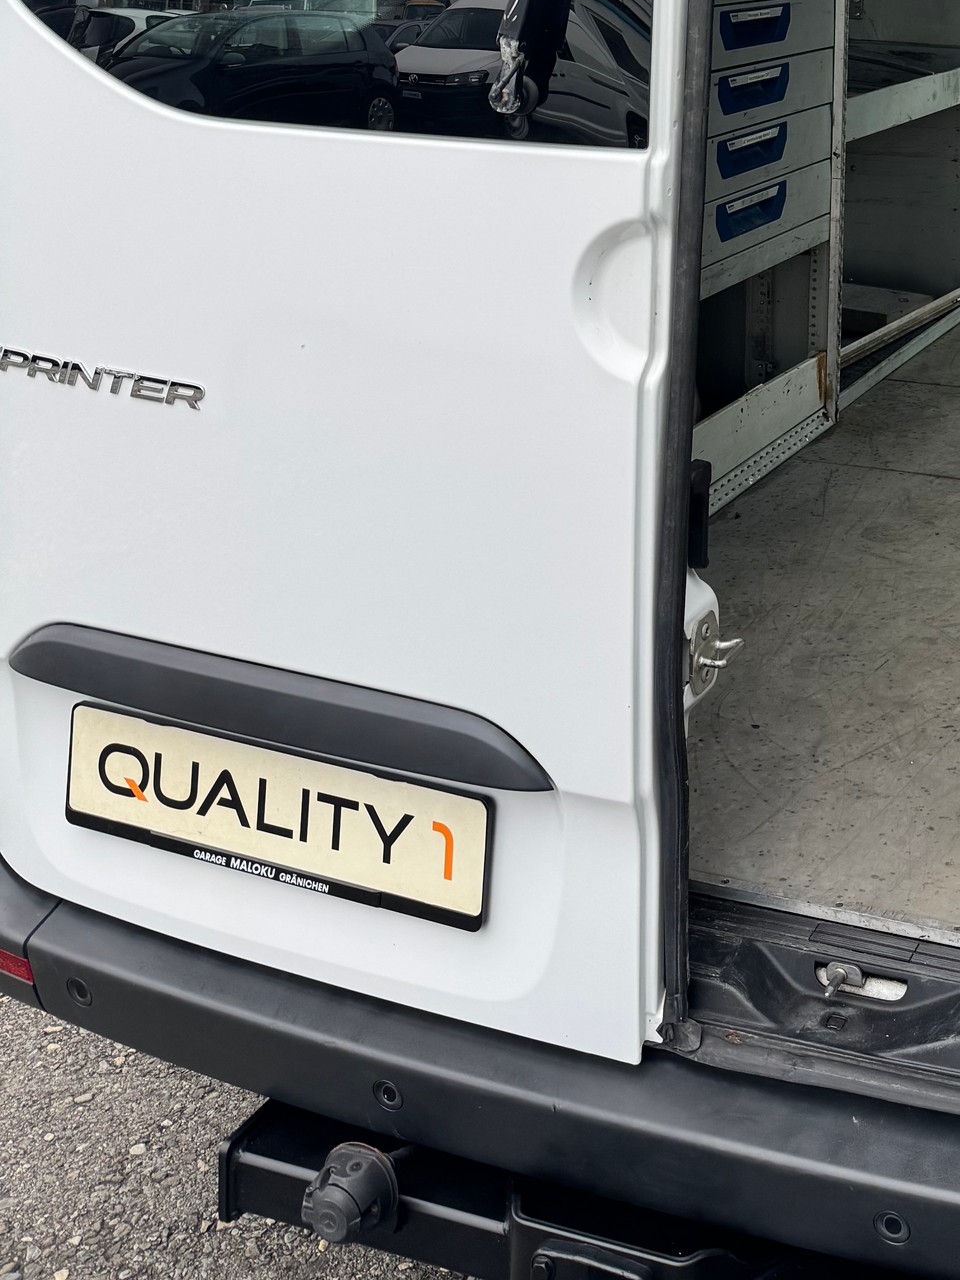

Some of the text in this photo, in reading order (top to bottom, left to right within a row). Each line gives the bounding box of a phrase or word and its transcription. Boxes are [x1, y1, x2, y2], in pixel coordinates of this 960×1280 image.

[0, 345, 206, 410] PRINTER
[193, 849, 330, 894] GARAGE MALOKU GRÄNICHEN
